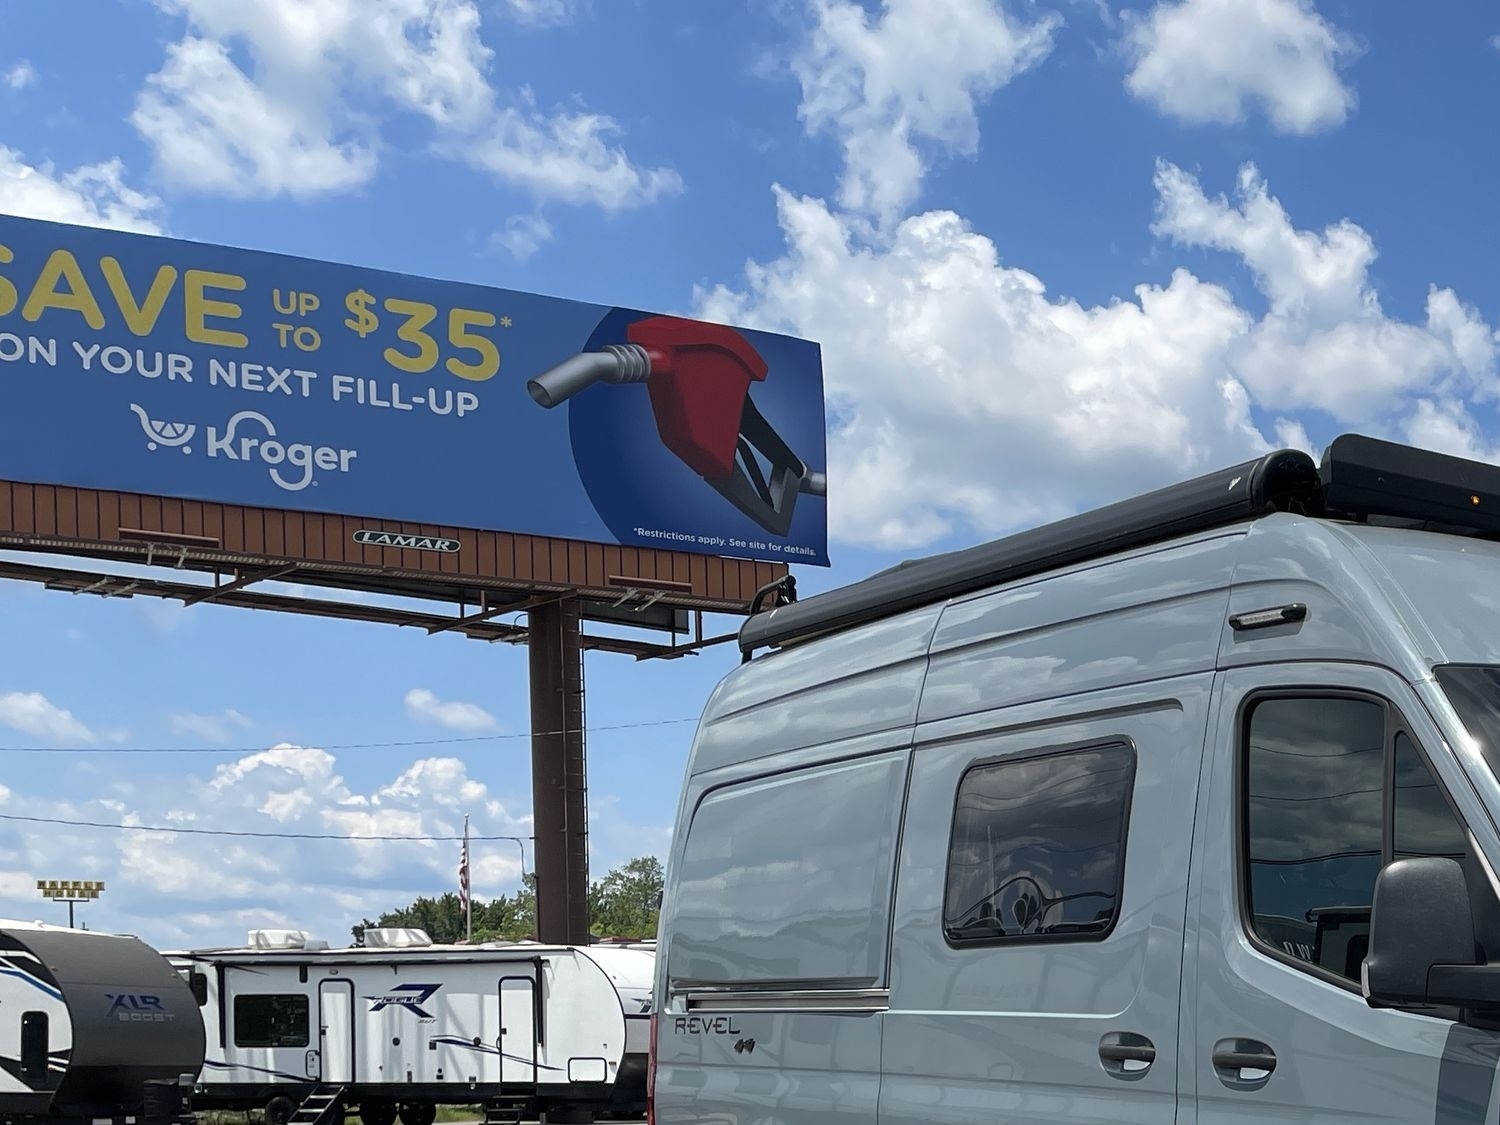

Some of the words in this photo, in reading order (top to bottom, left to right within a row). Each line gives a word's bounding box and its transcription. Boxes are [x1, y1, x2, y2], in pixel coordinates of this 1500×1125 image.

[272, 288, 321, 317] UP
[271, 322, 322, 352] TO
[0, 332, 57, 366] ON
[72, 341, 194, 384] YOUR
[209, 358, 318, 398] NEXT
[332, 374, 480, 417] FILL-UP
[206, 410, 358, 492] Kroger
[361, 531, 451, 551] LAMAR
[697, 536, 727, 547] apply.
[729, 538, 747, 549] See
[749, 540, 766, 551] site
[768, 541, 782, 552] for
[784, 544, 817, 557] details.
[104, 993, 166, 1017] XLR
[118, 1012, 176, 1022] BOOST
[674, 1016, 741, 1035] REVEL
